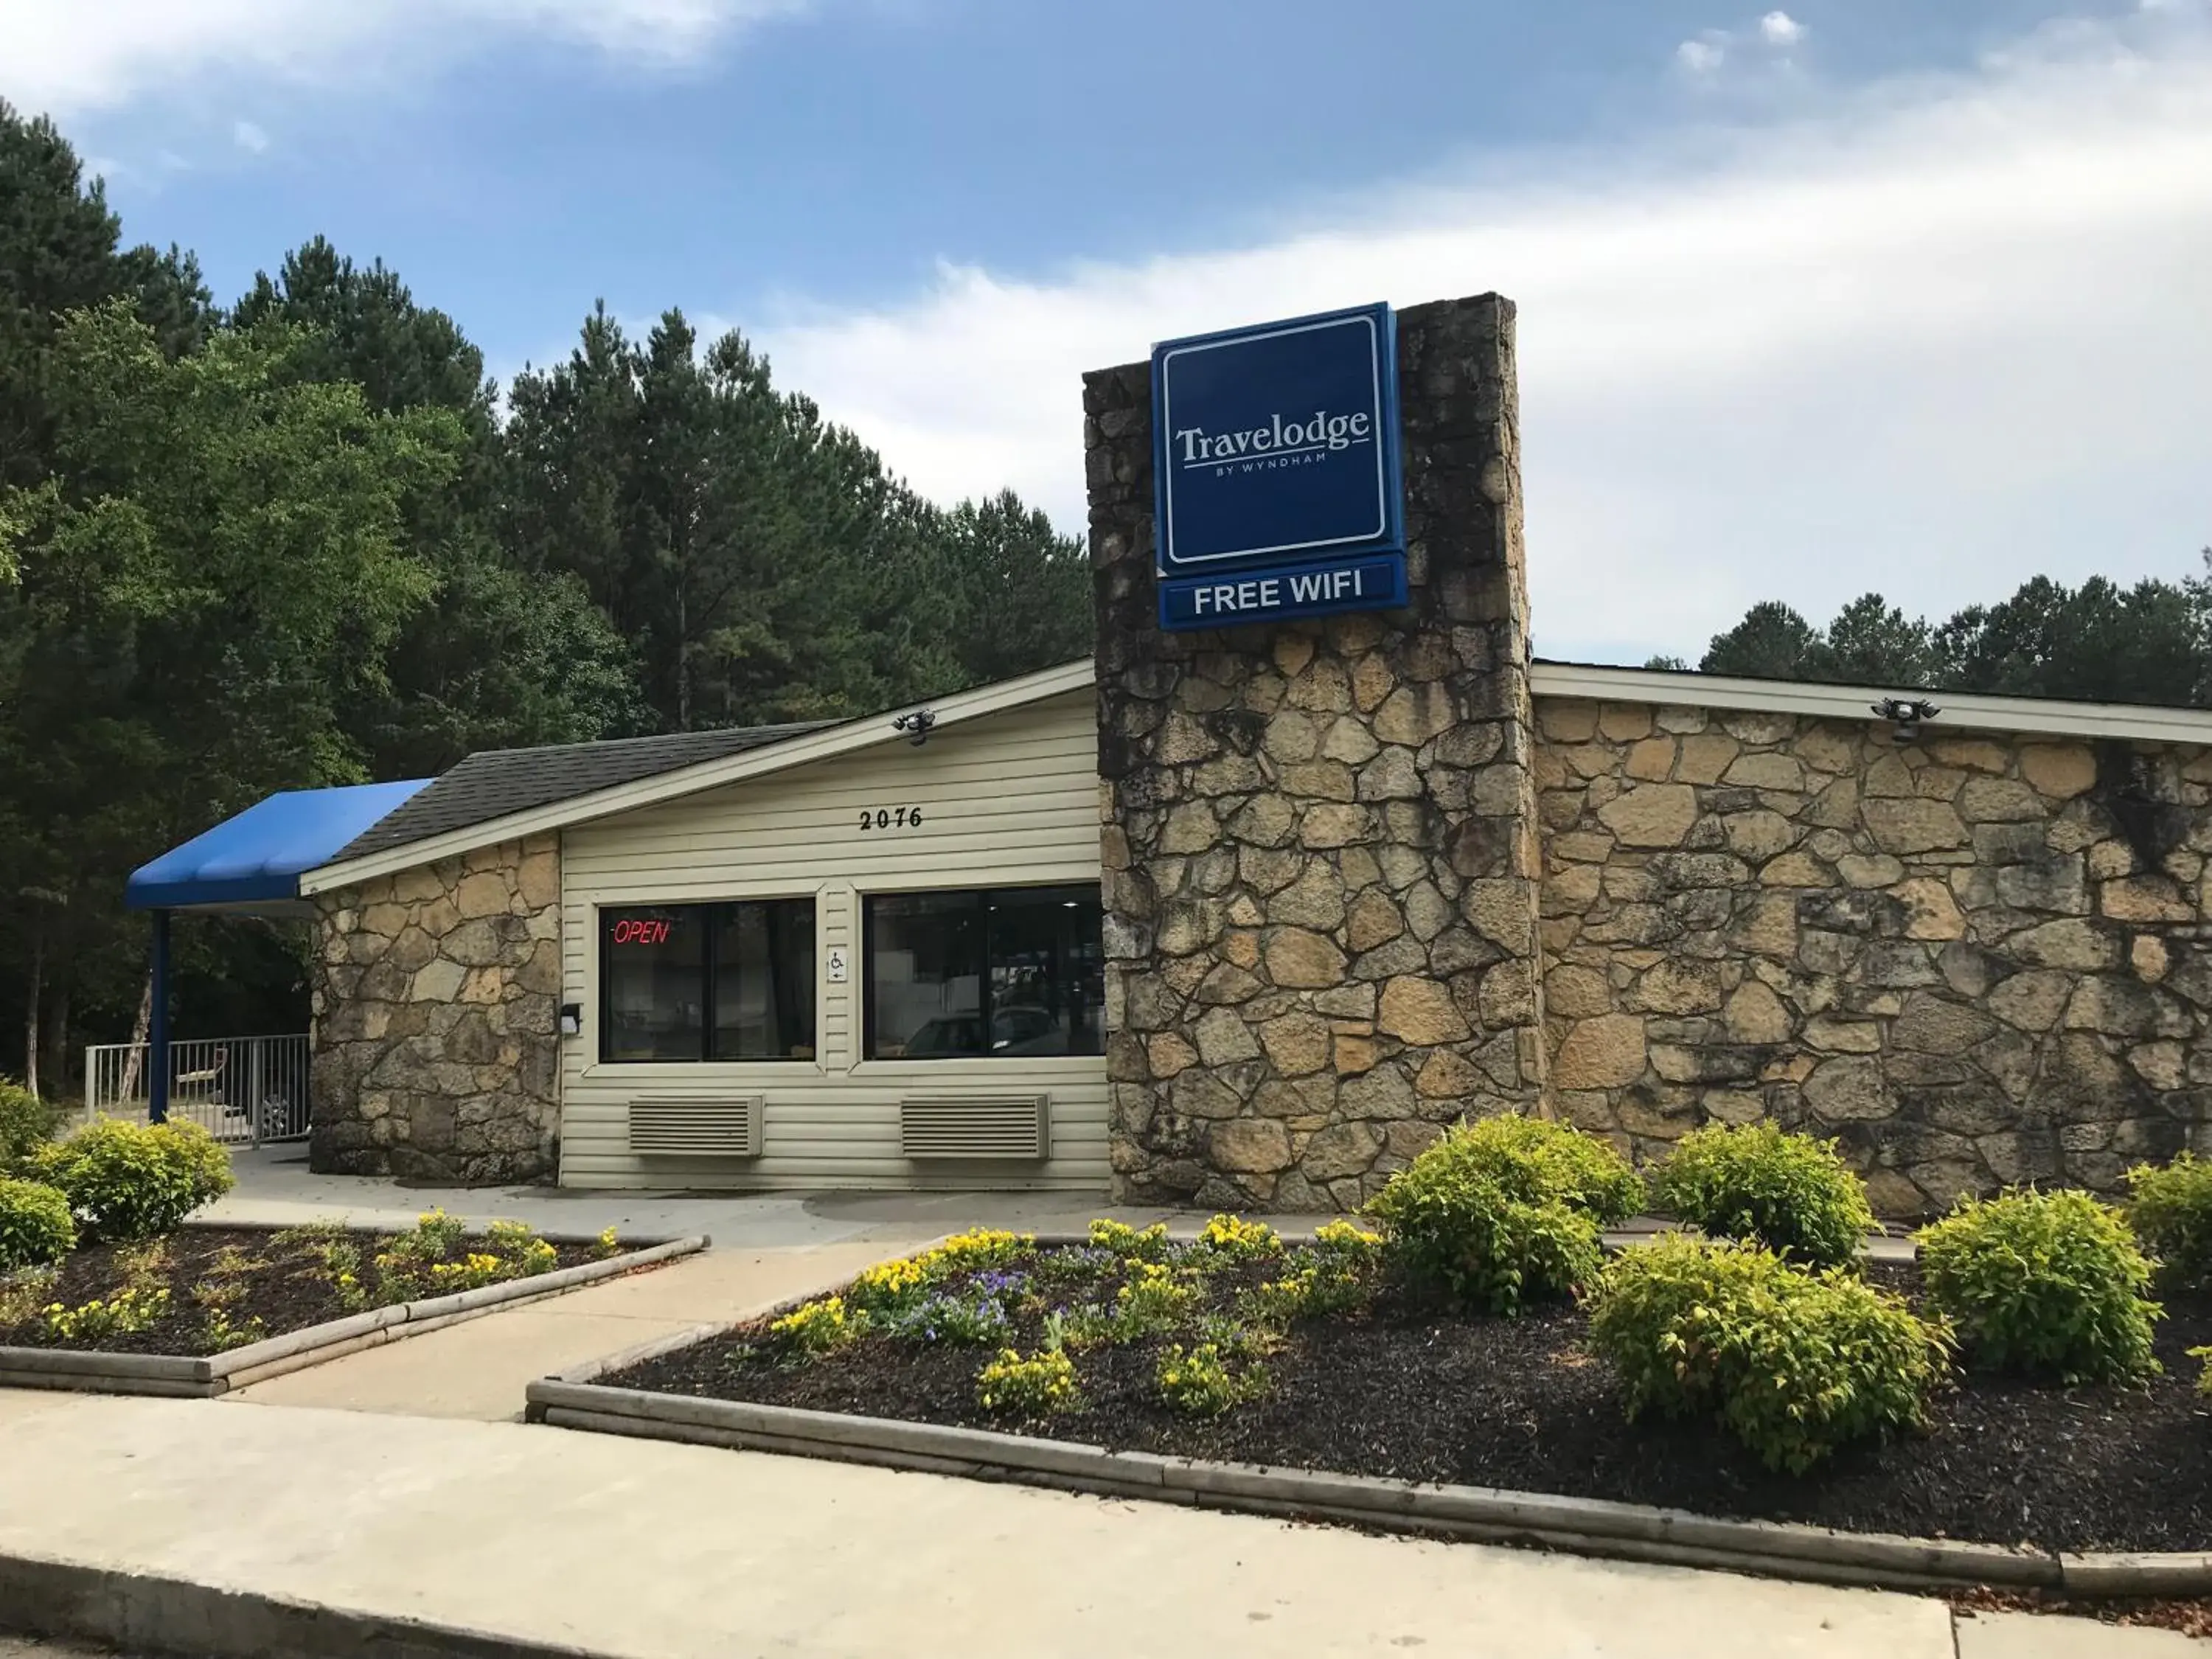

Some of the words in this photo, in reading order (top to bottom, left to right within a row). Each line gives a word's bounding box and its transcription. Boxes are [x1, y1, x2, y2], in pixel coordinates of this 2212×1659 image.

[1175, 411, 1369, 461] Travelodge
[1217, 466, 1234, 478] BY
[1242, 453, 1326, 473] WYNDHAM
[1194, 580, 1281, 614] FREE
[1290, 569, 1363, 603] WIFI
[860, 807, 922, 830] 2076
[613, 920, 669, 944] OPEN
